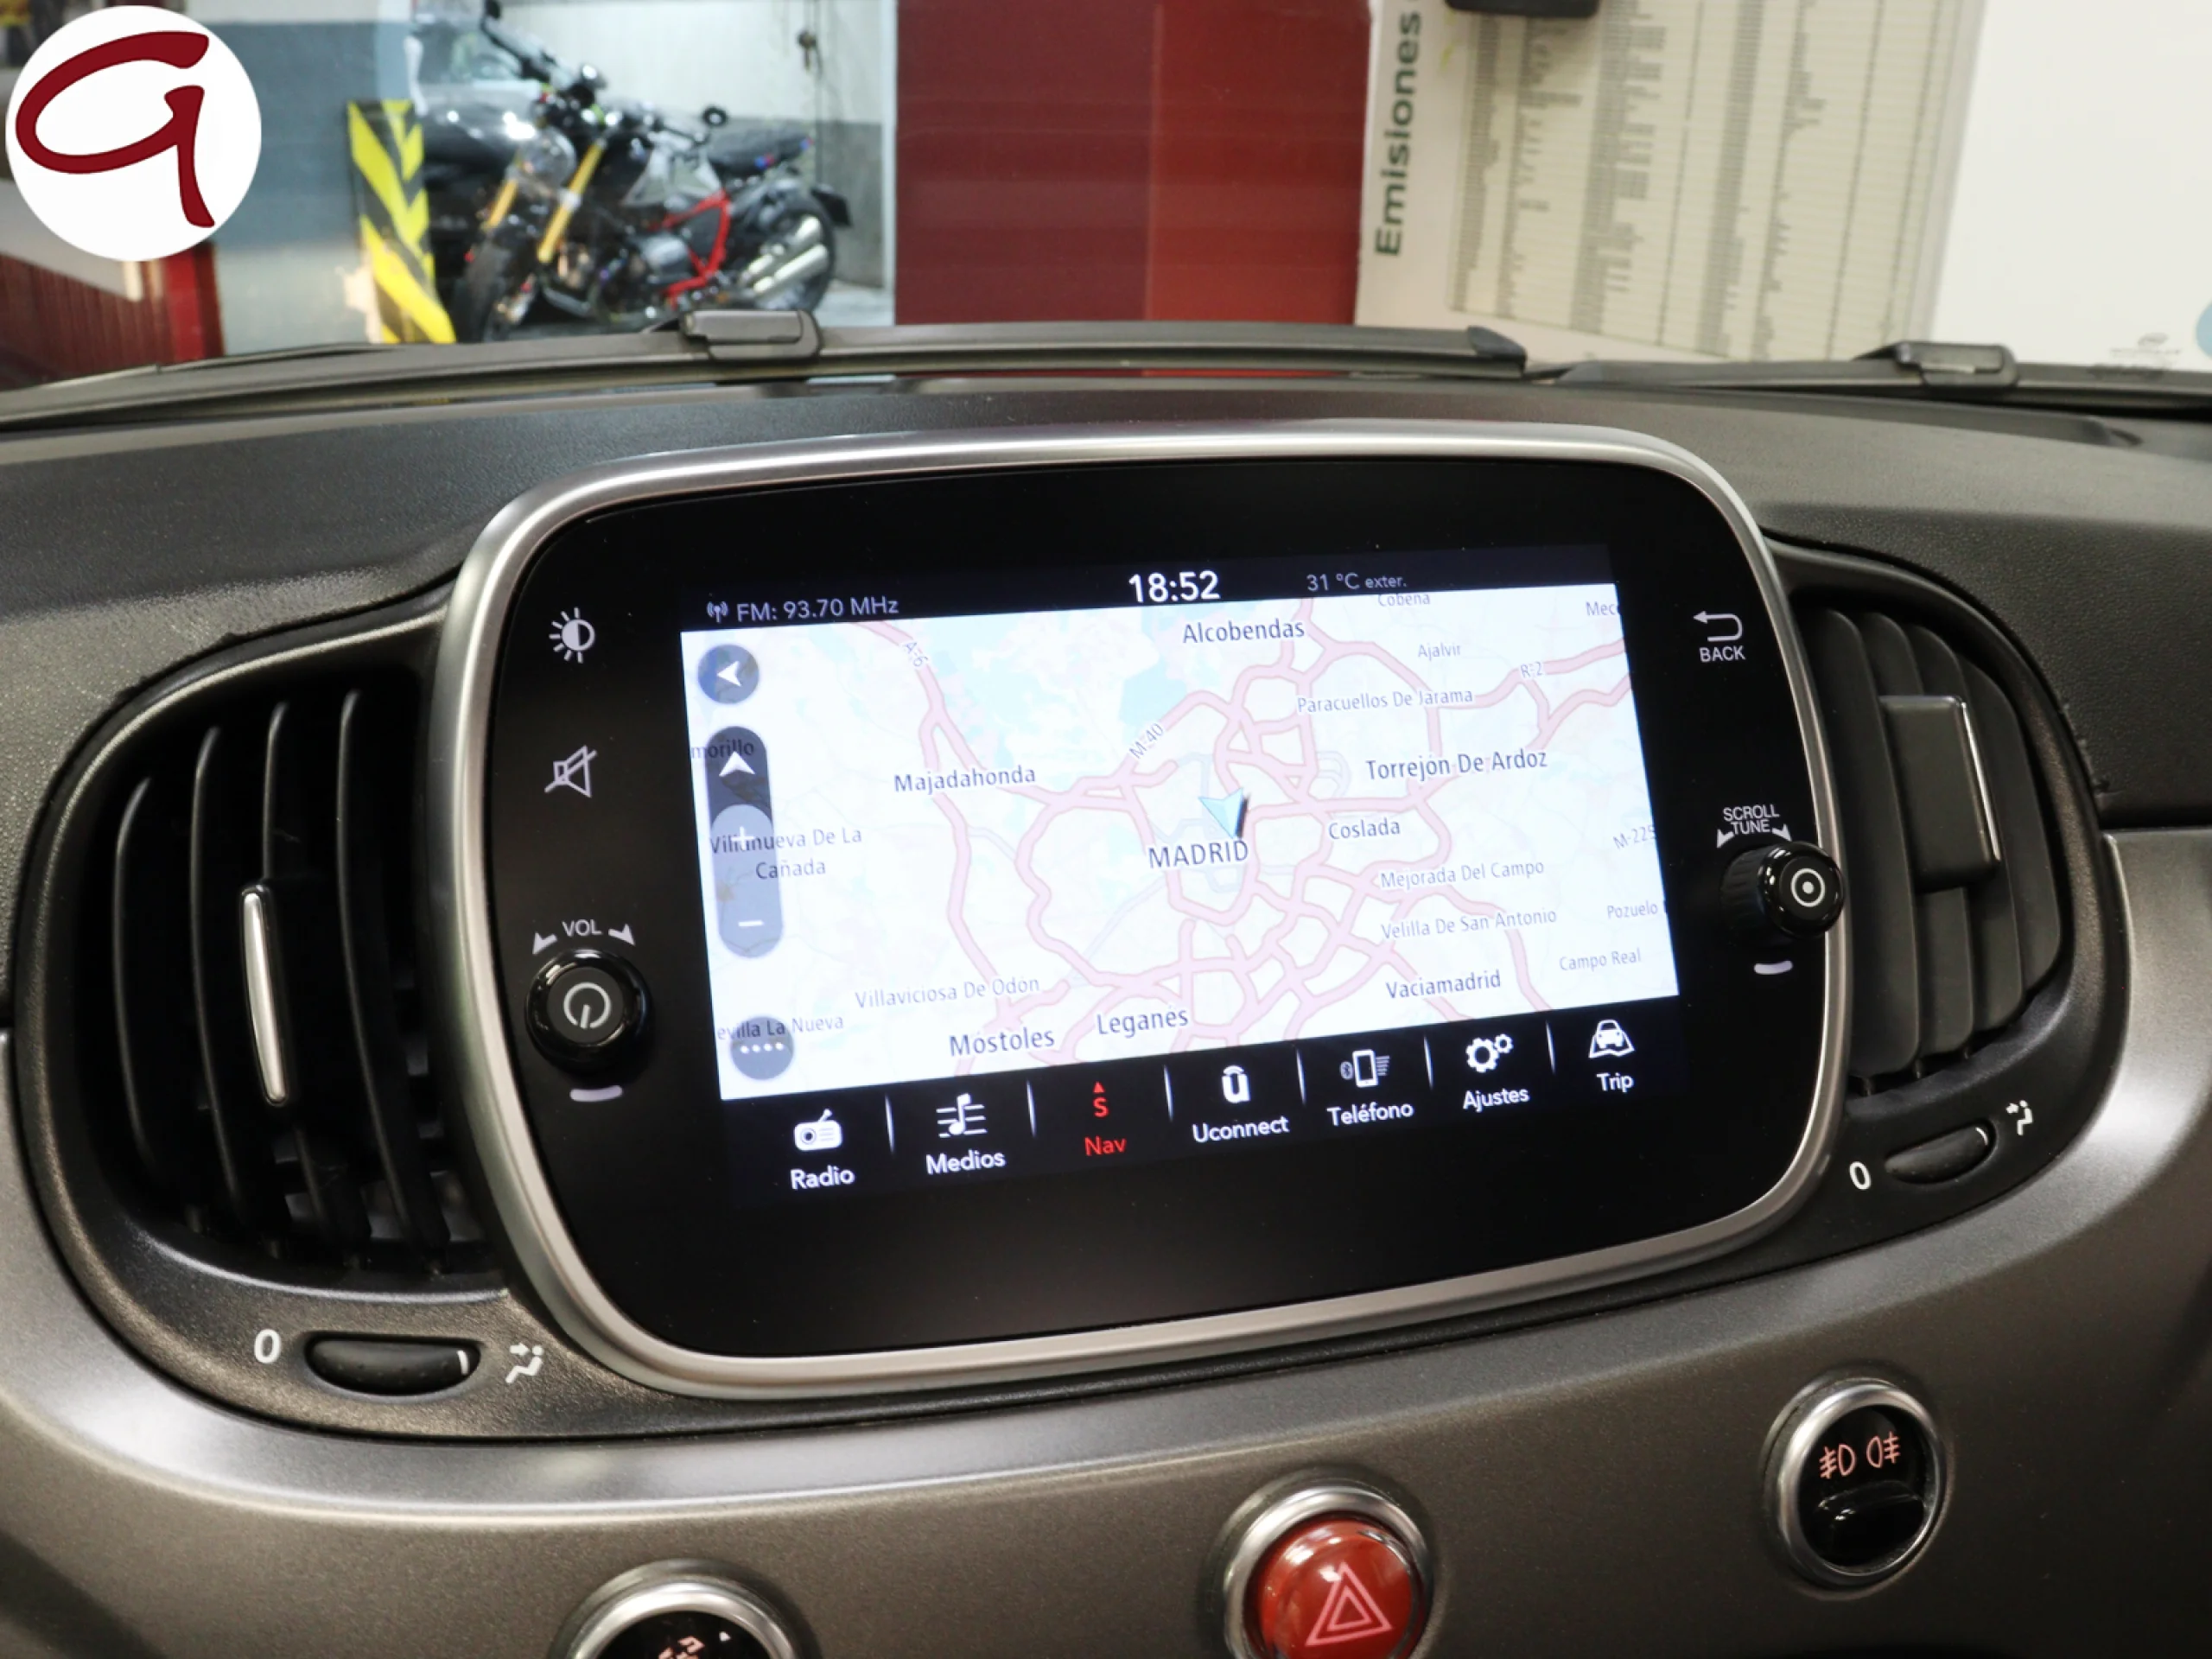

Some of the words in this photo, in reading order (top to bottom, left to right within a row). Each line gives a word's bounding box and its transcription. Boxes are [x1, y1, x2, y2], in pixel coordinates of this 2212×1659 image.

[1374, 10, 1421, 257] Emisiones
[1128, 570, 1220, 603] 18:52
[1306, 574, 1330, 591] 31
[1336, 572, 1360, 590] °C
[1364, 576, 1408, 588] exter.
[737, 603, 778, 621] FM:
[783, 600, 844, 620] 93.70
[850, 597, 899, 615] MHz
[1182, 618, 1306, 644] Alcobendas
[904, 641, 929, 668] A-6
[1418, 643, 1461, 660] Ajalvir
[1700, 645, 1746, 662] BACK
[1297, 695, 1389, 713] Paracuellos
[1394, 693, 1413, 708] De
[1419, 690, 1473, 706] Jarama
[1129, 722, 1166, 760] M-40
[1457, 753, 1484, 772] De
[1491, 748, 1548, 770] Ardoz
[893, 766, 1035, 793] Majadahonda
[1723, 804, 1781, 822] SCROLL
[812, 829, 836, 846] De
[842, 827, 862, 844] La
[1328, 818, 1402, 841] Coslada
[1730, 819, 1770, 835] TUNE
[1148, 840, 1249, 868] MADRID
[756, 858, 827, 880] Cañada
[1381, 868, 1457, 891] Mejorada
[1462, 866, 1486, 881] Del
[1492, 861, 1545, 883] Campo
[1607, 900, 1658, 919] Pozuelo
[562, 918, 602, 938] VOL
[1382, 921, 1430, 940] Velilla
[1436, 919, 1456, 934] De
[1460, 914, 1491, 931] San
[1496, 907, 1557, 929] Antonio
[1560, 954, 1607, 971] Campo
[1611, 947, 1641, 964] Real
[855, 985, 957, 1009] Villaviciosa
[963, 979, 987, 1000] De
[1386, 970, 1502, 999] Vaciamadrid
[766, 1018, 785, 1036] La
[791, 1014, 845, 1033] Nueva
[1597, 1071, 1635, 1095] Trip
[1463, 1086, 1530, 1111] Ajustes
[1326, 1101, 1414, 1127] Teléfono
[1192, 1116, 1291, 1143] Uconnect
[1084, 1136, 1128, 1156] Nav
[926, 1150, 1006, 1175] Medios
[790, 1165, 855, 1190] Radio
[1849, 1161, 1872, 1191] 0
[254, 1329, 282, 1364] 0
